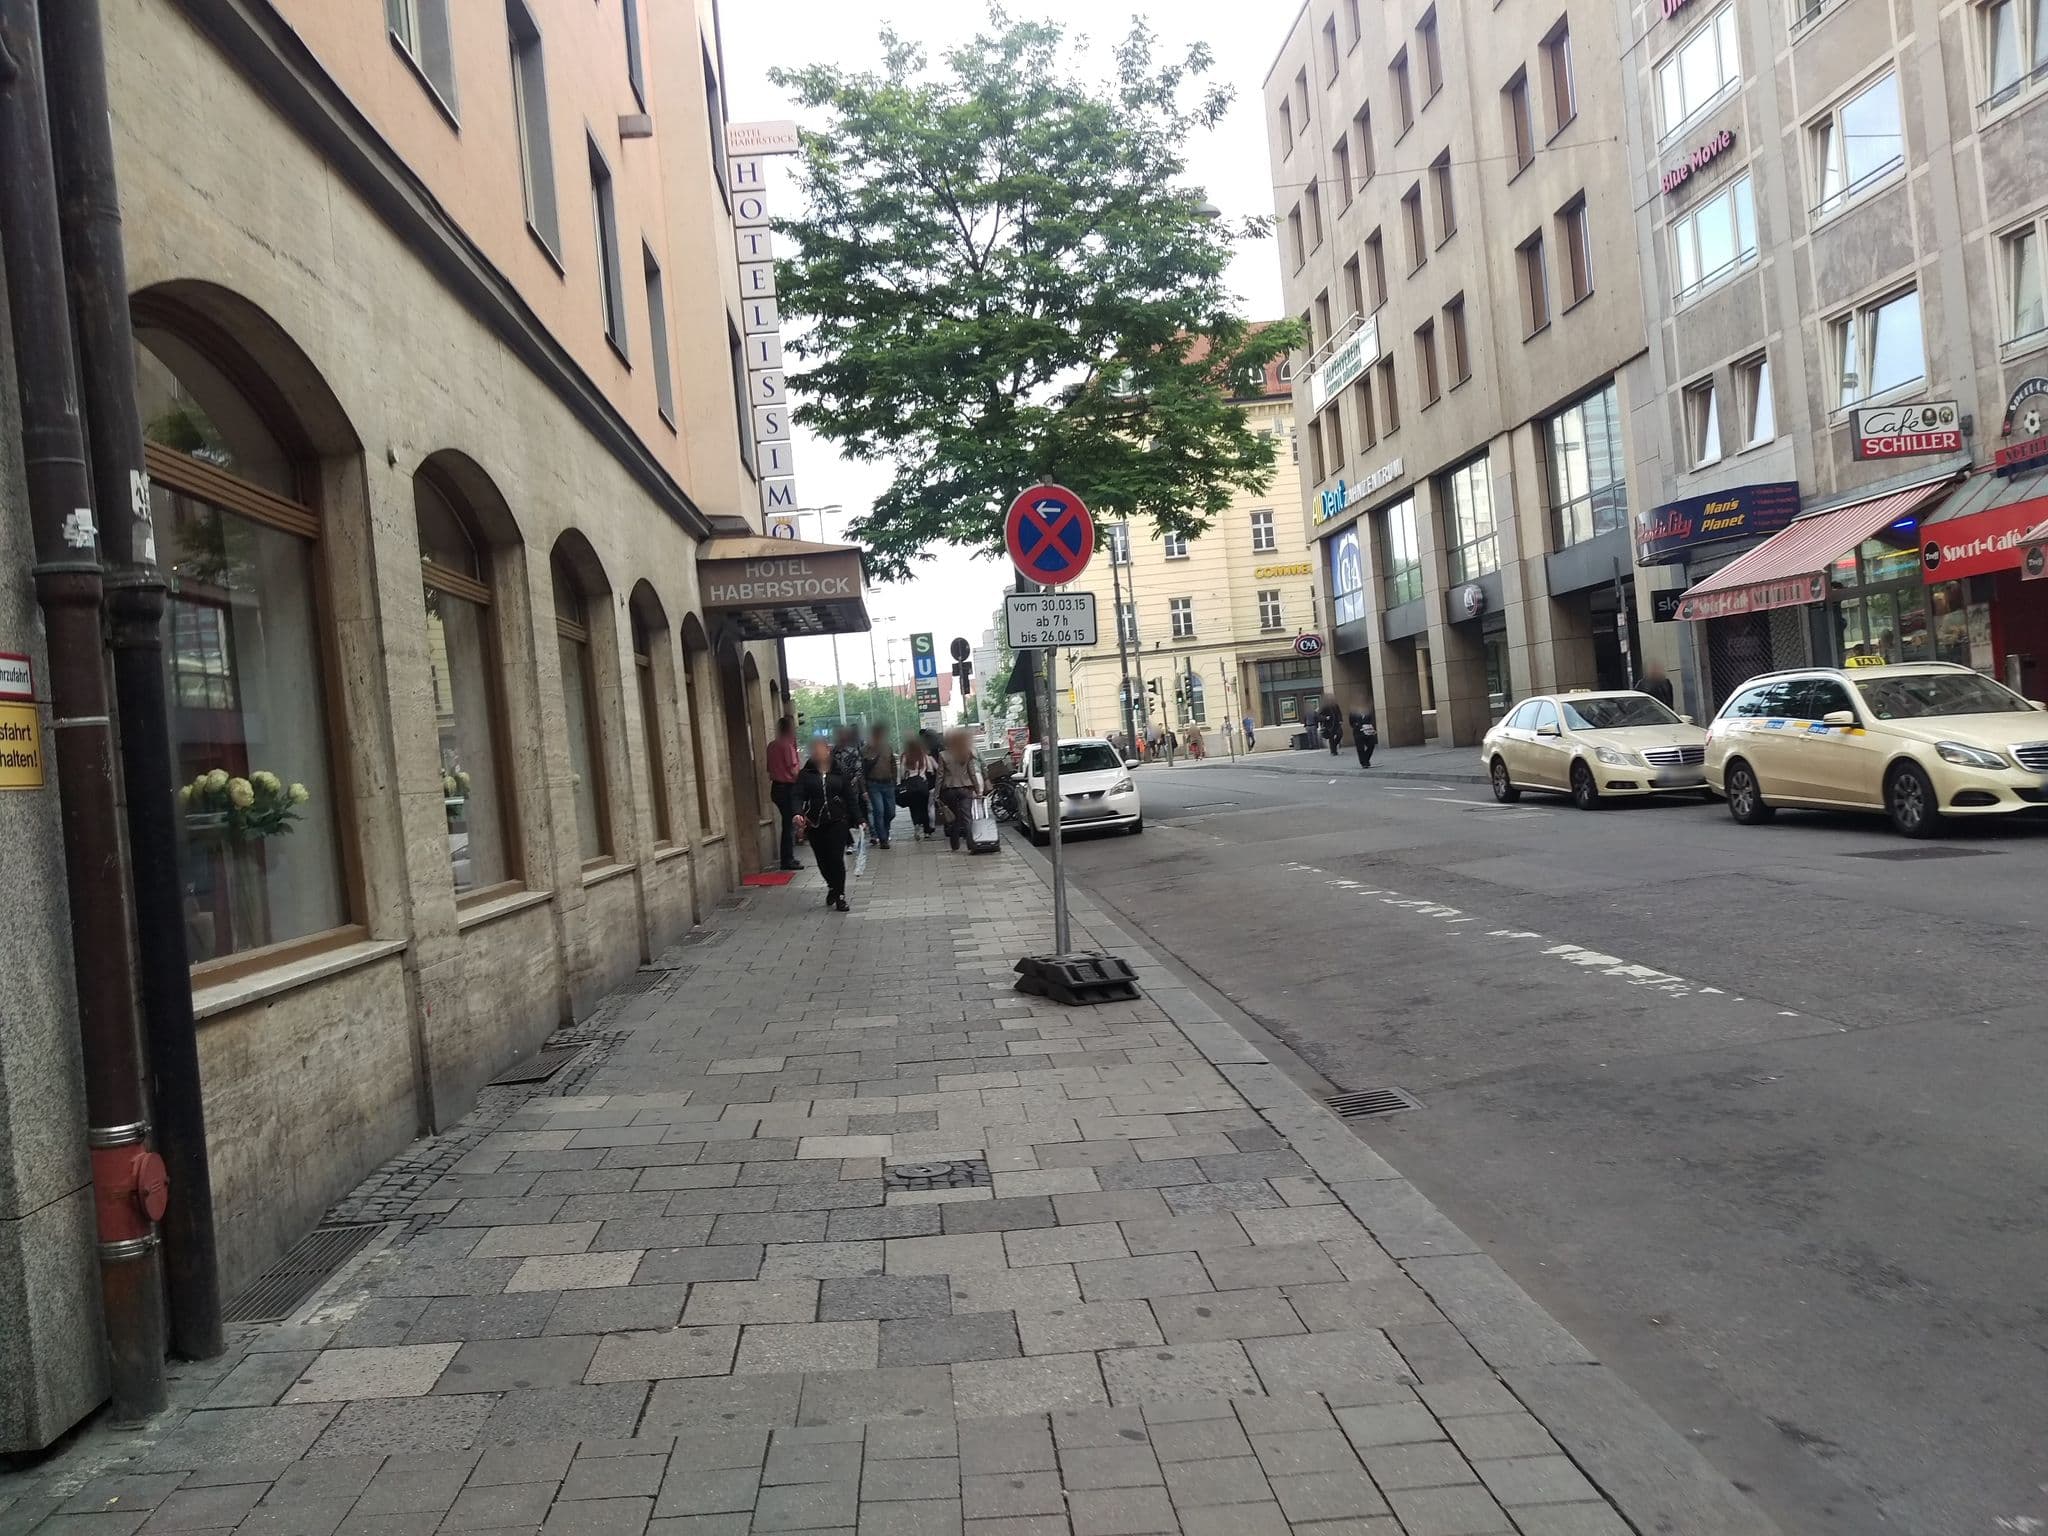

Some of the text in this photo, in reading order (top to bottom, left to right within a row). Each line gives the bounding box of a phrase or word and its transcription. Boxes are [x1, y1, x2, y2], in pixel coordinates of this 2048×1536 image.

[1662, 130, 1731, 195] Blue Movie
[1864, 408, 1939, 436] Café
[1866, 433, 1956, 455] SCHILLER
[1700, 514, 1745, 533] Planet
[1943, 528, 2022, 563] Sport-Café
[745, 559, 813, 578] HOTEL
[710, 577, 850, 601] HABERSTOCK
[1014, 598, 1086, 612] vom 30.03.15
[1036, 615, 1069, 627] ab 7 h
[916, 636, 929, 653] S
[1021, 632, 1037, 643] bis
[918, 658, 932, 676] U
[1857, 658, 1880, 666] TAXI
